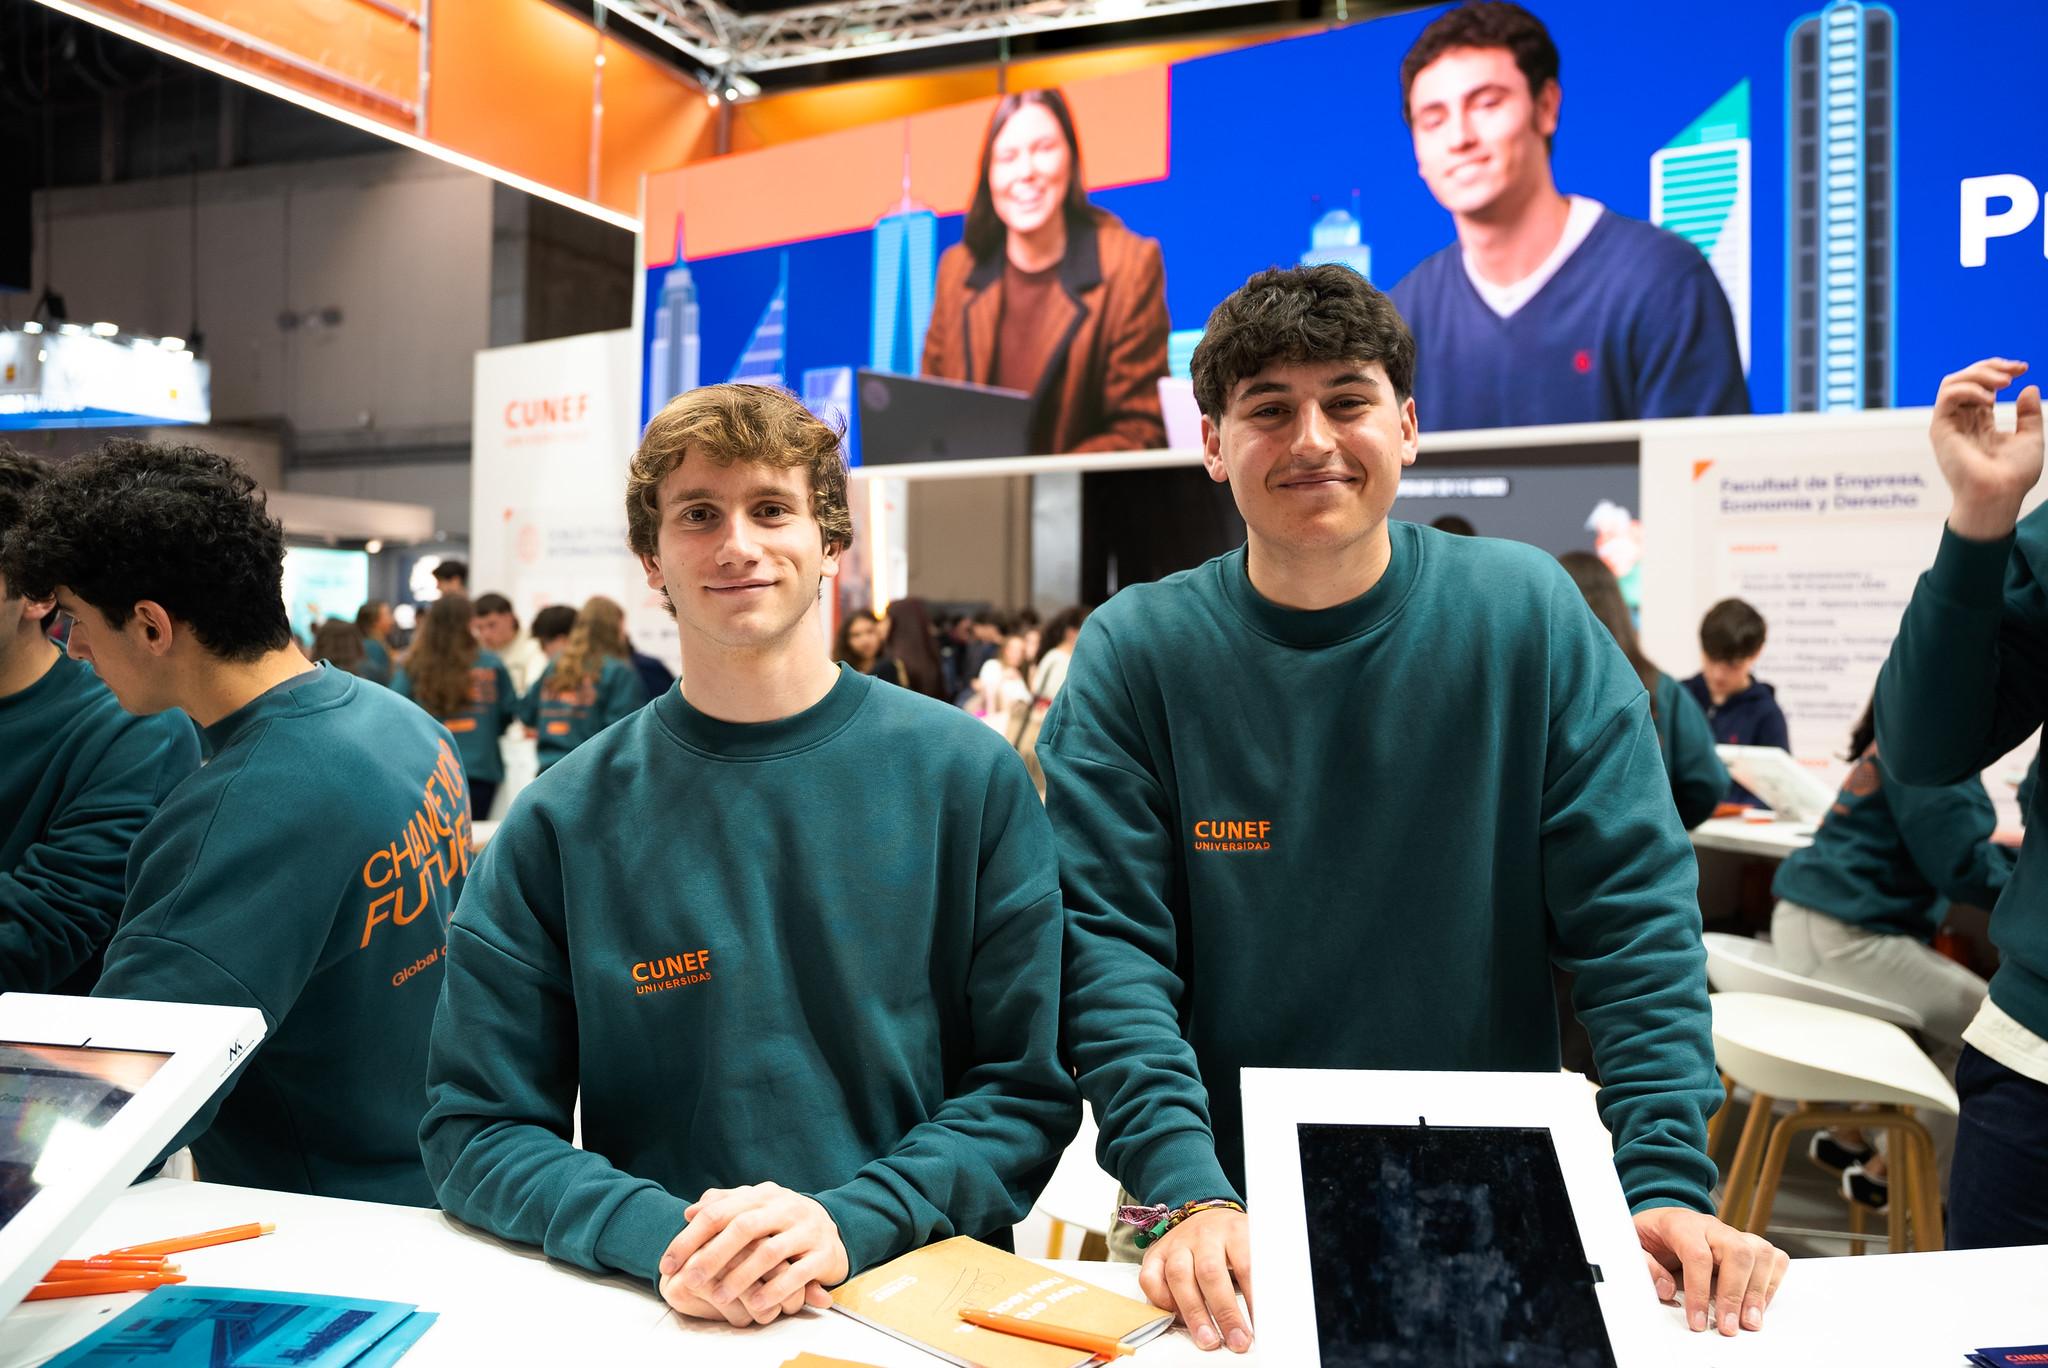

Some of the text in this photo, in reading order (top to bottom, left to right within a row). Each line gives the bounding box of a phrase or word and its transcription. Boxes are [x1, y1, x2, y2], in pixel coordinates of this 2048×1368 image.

[1960, 173, 2048, 268] P
[504, 393, 589, 429] CUNEF
[1721, 475, 1800, 492] Facultad
[1805, 475, 1828, 490] de
[1818, 497, 1828, 515] y
[1833, 492, 1919, 509] Derecho
[1194, 820, 1272, 840] CUNEF
[1195, 841, 1271, 852] UNIVERSIDAD
[392, 947, 439, 987] Global
[631, 948, 710, 983] CUNEF
[635, 971, 712, 995] UNIVERSIDAD
